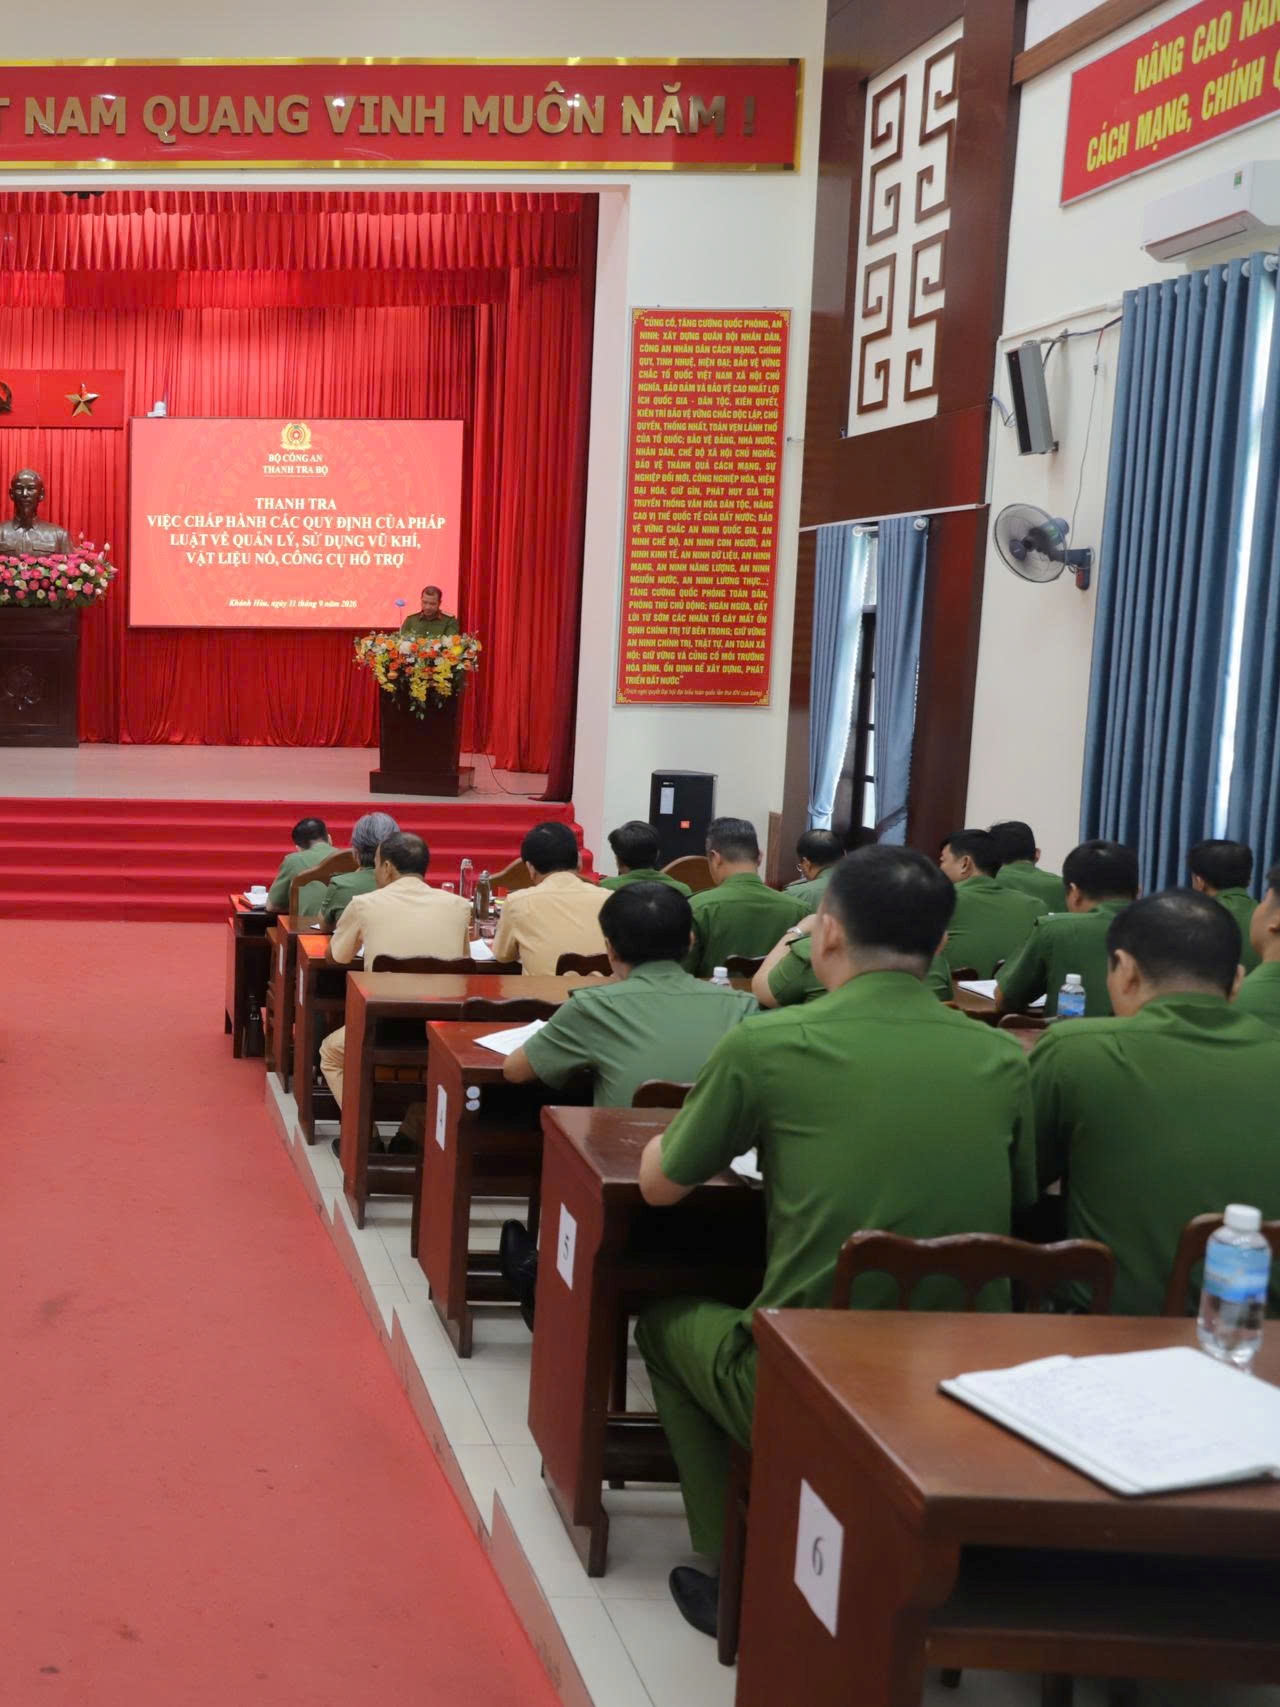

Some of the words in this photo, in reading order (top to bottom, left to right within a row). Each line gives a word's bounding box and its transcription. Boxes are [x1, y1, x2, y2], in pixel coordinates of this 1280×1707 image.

[1134, 36, 1185, 94] NÂNG
[1191, 10, 1232, 64] CAO
[25, 96, 127, 137] NAM
[142, 94, 310, 145] QUANG
[323, 94, 446, 135] VINH
[463, 80, 607, 136] MUÔN
[621, 81, 728, 136] NĂM
[743, 94, 755, 138] !
[1086, 121, 1130, 172] CÁCH
[1135, 93, 1192, 152] MẠNG,
[1201, 56, 1266, 121] CHÍNH
[147, 513, 181, 531] VIỆC
[184, 511, 224, 528] CHẤP
[226, 512, 267, 528] HÀNH
[270, 512, 300, 529] CÁC
[303, 516, 333, 530] QUY
[336, 516, 372, 532] ĐỊNH
[375, 513, 405, 529] CỦA
[408, 513, 446, 529] PHÁP
[255, 497, 305, 510] THANH
[308, 498, 337, 510] TRA
[170, 532, 208, 548] LUẬT
[210, 530, 230, 546] VỀ
[233, 531, 273, 548] QUẢN
[276, 531, 299, 548] LÝ,
[302, 531, 322, 548] SỬ
[325, 535, 365, 550] DỤNG
[368, 532, 387, 548] VŨ
[391, 532, 421, 550] KHÍ,
[812, 1536, 824, 1576] 6
